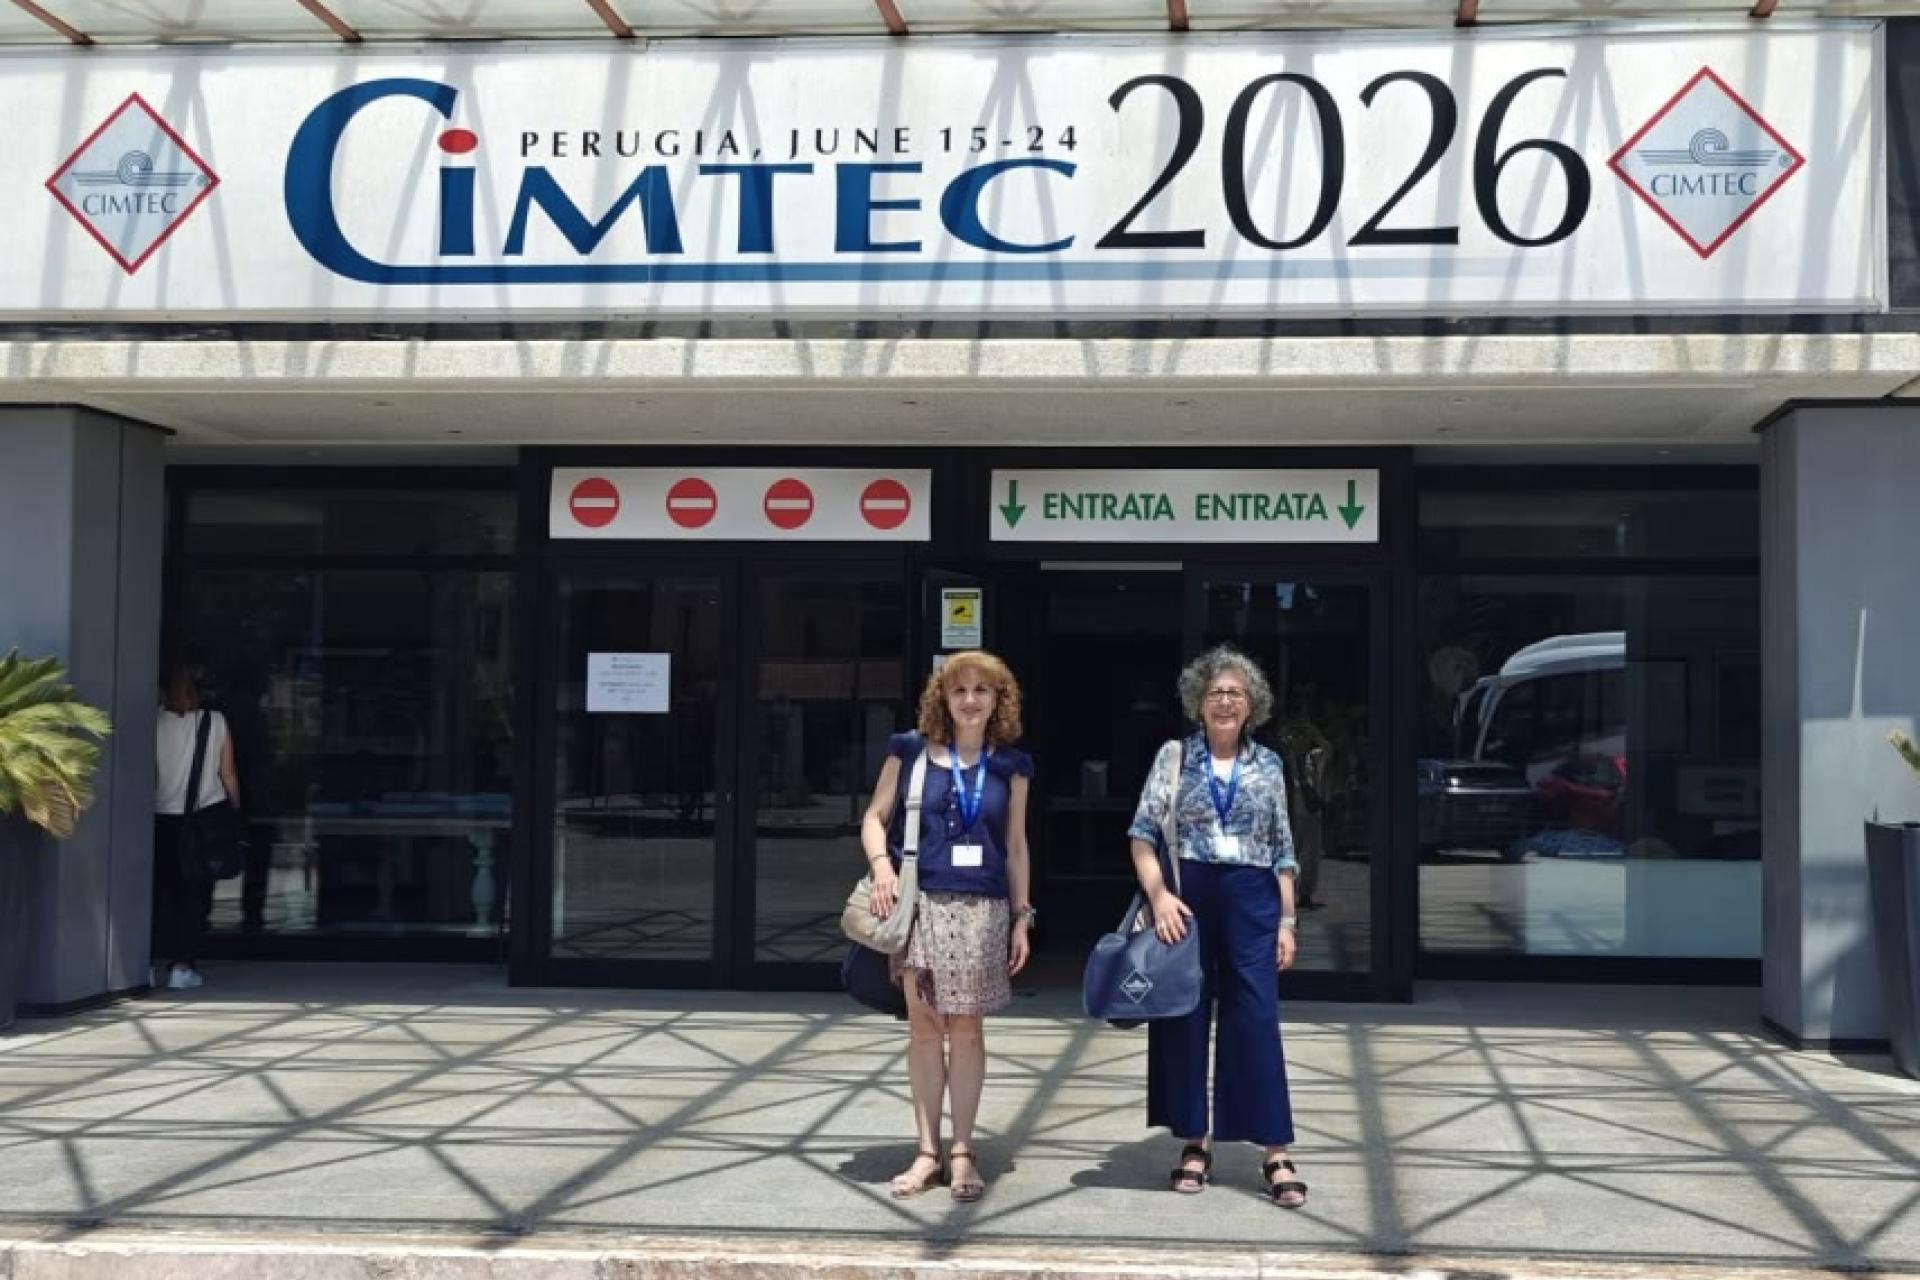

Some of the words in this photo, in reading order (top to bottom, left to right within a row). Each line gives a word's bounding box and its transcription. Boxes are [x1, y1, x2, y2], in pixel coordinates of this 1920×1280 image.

[520, 128, 762, 159] PERUGIA,
[787, 126, 912, 160] JUNE
[940, 125, 1078, 153] 15-24
[1095, 66, 1592, 251] 2026
[1650, 171, 1758, 197] CIMTEC
[82, 192, 179, 216] CIMTEC
[1042, 492, 1175, 521] ENTRATA
[1195, 492, 1328, 521] ENTRATA
